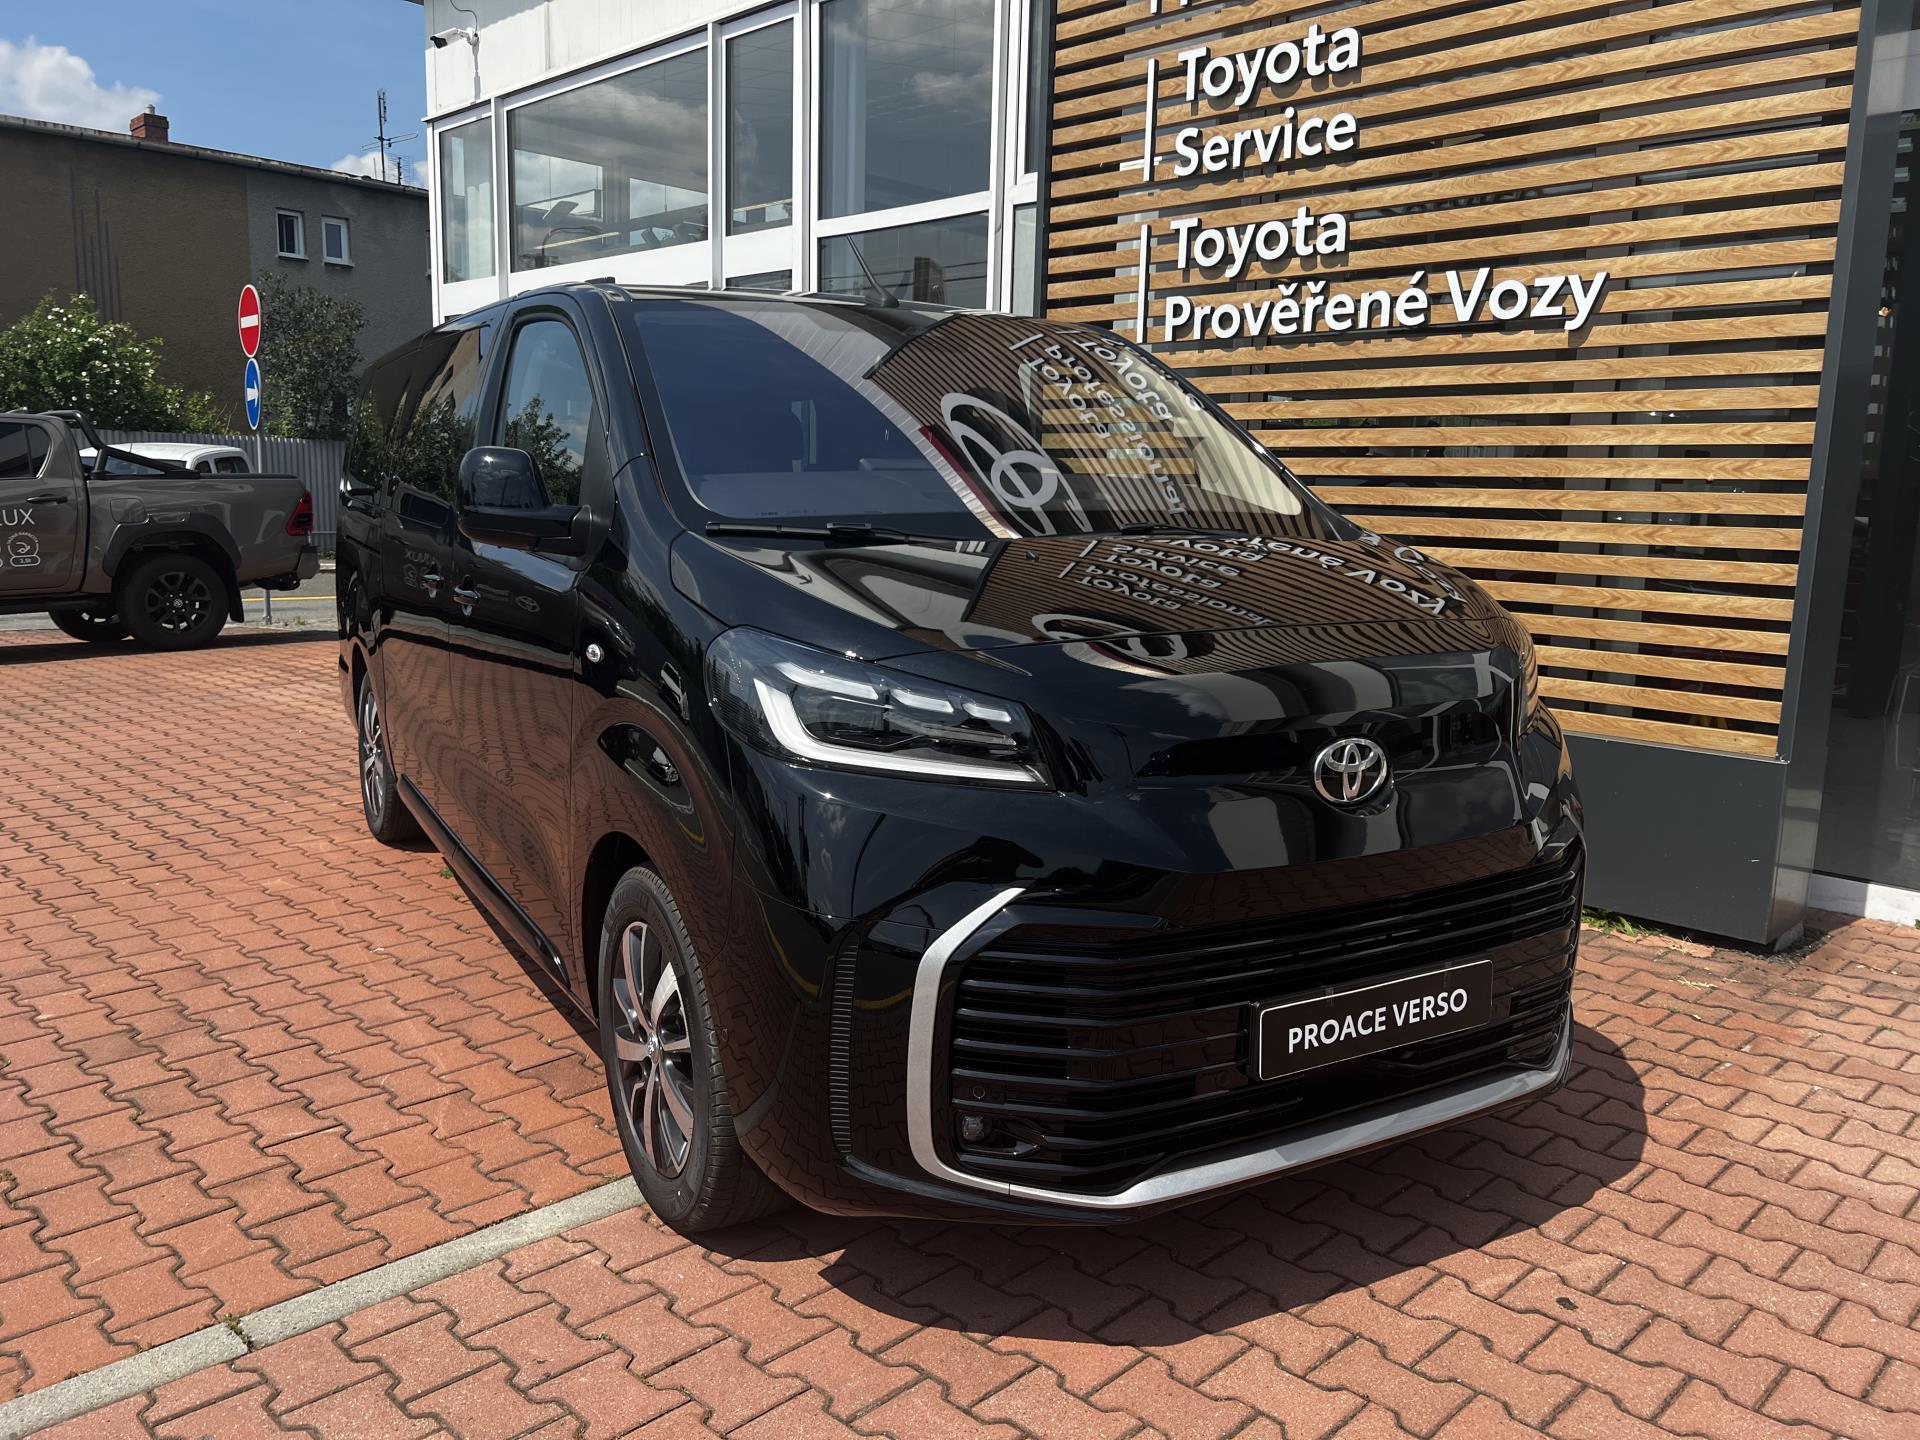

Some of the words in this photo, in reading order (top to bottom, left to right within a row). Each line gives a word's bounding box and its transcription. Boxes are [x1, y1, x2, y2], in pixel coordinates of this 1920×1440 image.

[1178, 23, 1362, 106] Toyota
[1173, 106, 1358, 178] Service
[1170, 205, 1348, 279] Toyota
[1164, 270, 1430, 343] Prověřené
[1445, 266, 1608, 332] Vozy
[0, 508, 36, 526] UX
[1288, 1006, 1387, 1054] PROACE
[1393, 988, 1468, 1027] VERSO
